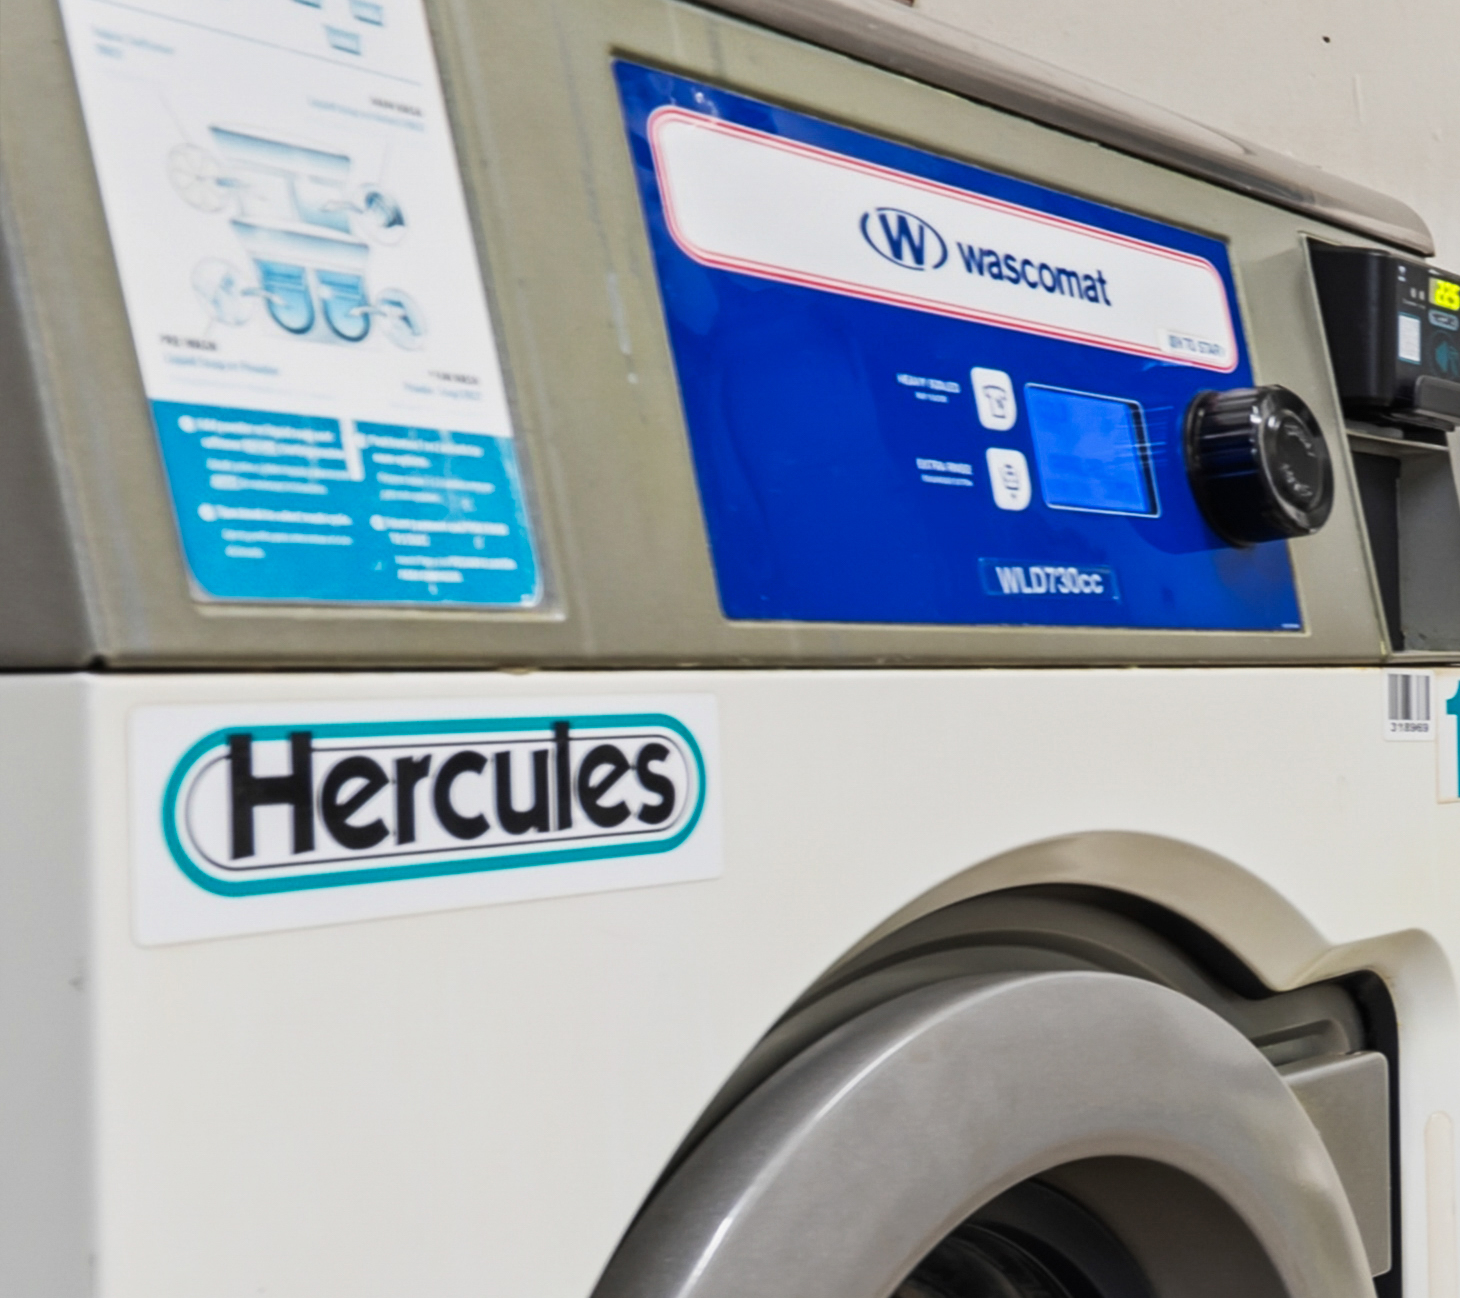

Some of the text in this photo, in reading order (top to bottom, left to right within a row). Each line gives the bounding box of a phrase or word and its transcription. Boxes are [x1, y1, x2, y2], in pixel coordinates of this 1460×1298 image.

[956, 241, 1112, 306] wascomat
[994, 565, 1104, 595] WLD730cc
[227, 720, 676, 860] Hercules
